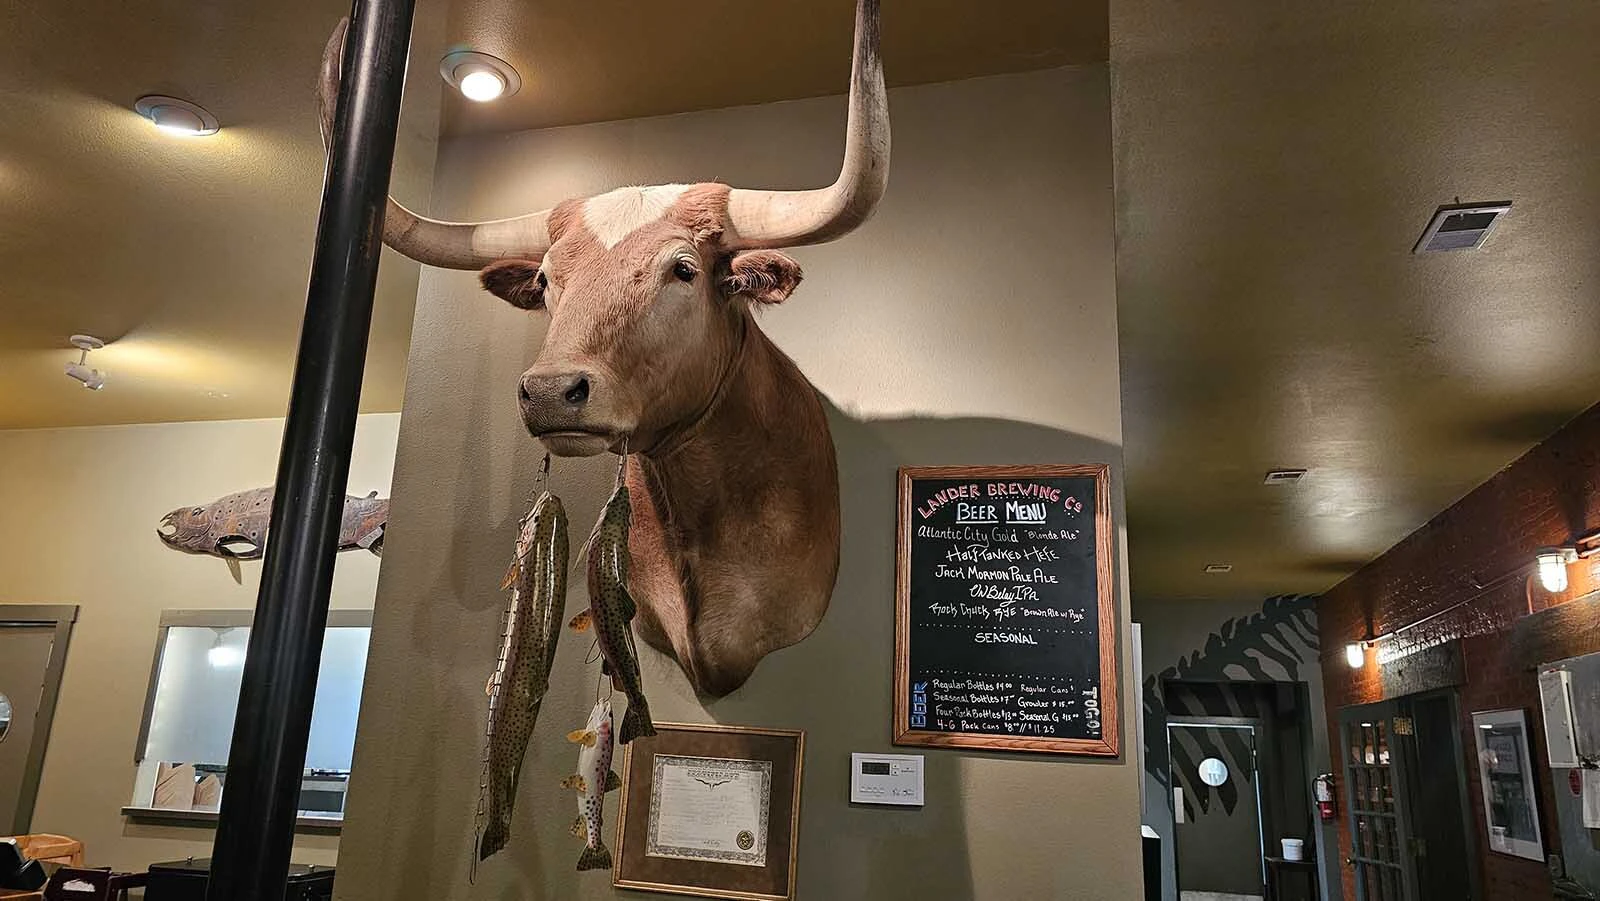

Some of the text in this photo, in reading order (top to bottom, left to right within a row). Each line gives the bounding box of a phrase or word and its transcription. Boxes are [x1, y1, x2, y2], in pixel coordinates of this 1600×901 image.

[918, 483, 981, 519] LANDER
[987, 483, 1062, 502] BREWING
[918, 525, 962, 541] Atlantic
[964, 526, 989, 548] City
[991, 527, 1019, 543] Gold
[1013, 584, 1040, 601] IPA
[974, 632, 1038, 645] SEASONAL
[932, 678, 966, 693] Regular
[966, 679, 995, 691] Bottles
[1020, 684, 1047, 696] Regular
[1050, 685, 1069, 694] Cans
[933, 691, 969, 703] Seasonal
[969, 693, 1000, 704] Bottles
[935, 704, 954, 717] Four
[972, 708, 1001, 719] Bottles
[961, 720, 979, 731] Pack
